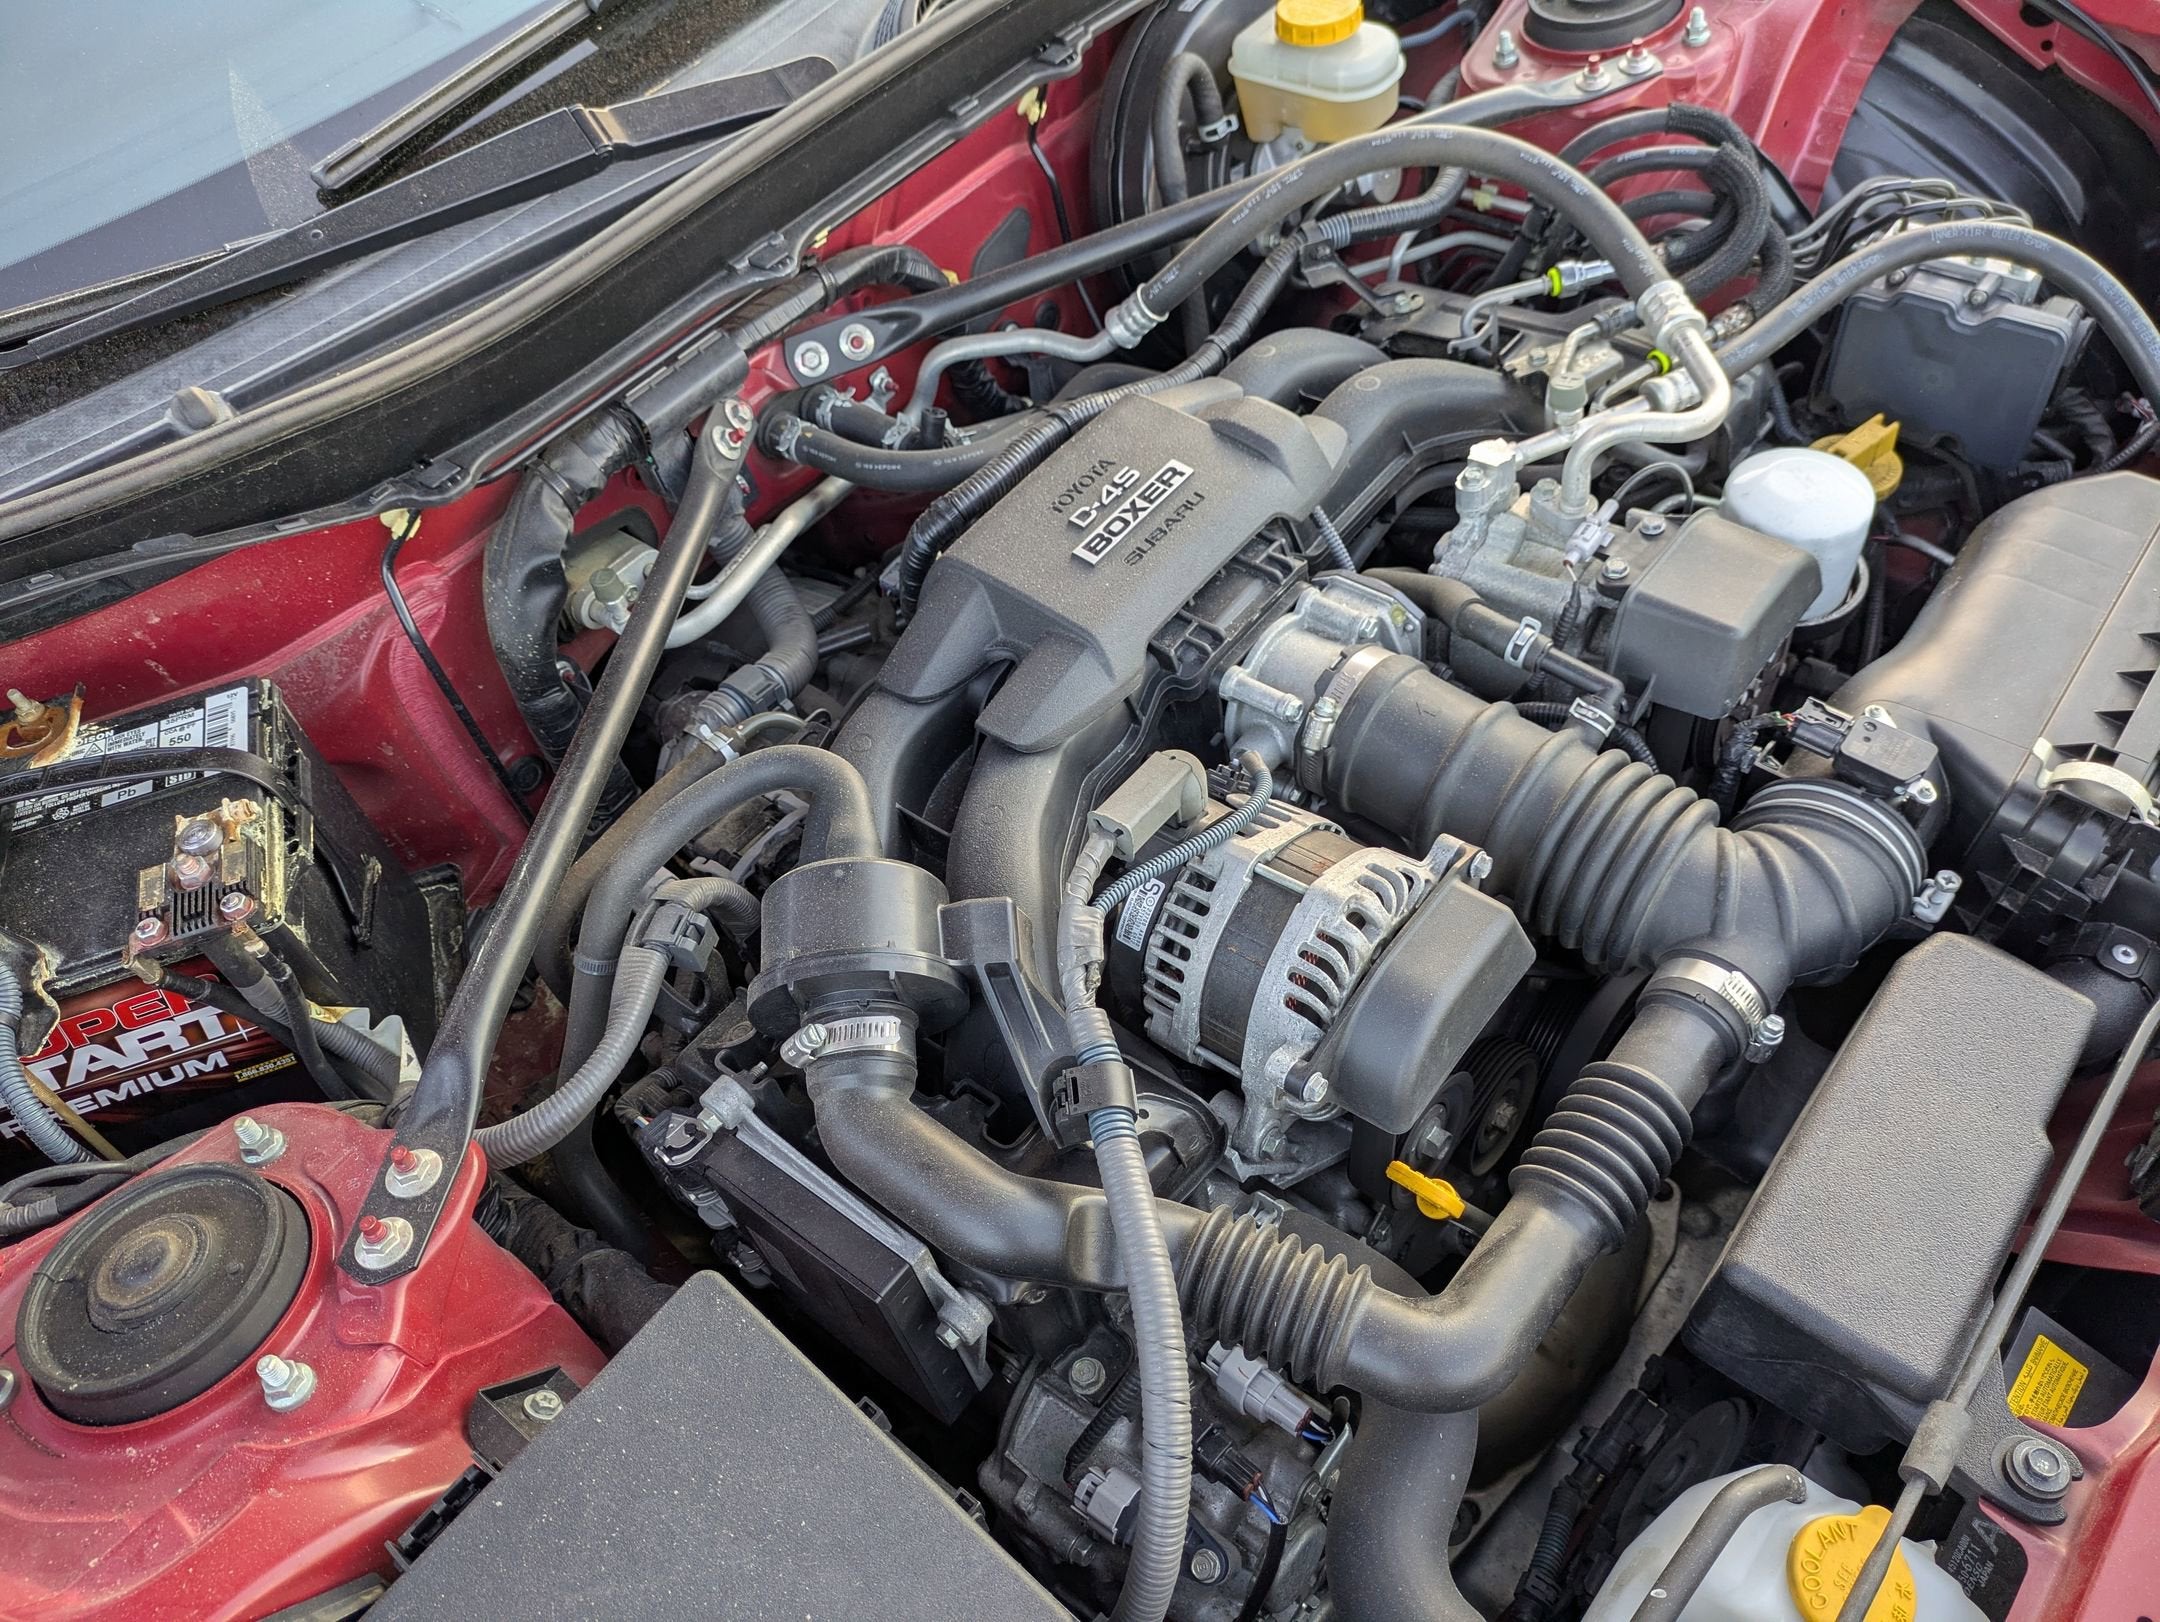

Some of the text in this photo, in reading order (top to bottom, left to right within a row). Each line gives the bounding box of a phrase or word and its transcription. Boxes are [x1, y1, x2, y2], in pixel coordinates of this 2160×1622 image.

[1052, 459, 1116, 514] TOYOTA
[1068, 466, 1141, 528] D-4S
[1081, 466, 1186, 557] BOXER
[1122, 491, 1206, 567] SUBARU
[168, 733, 192, 747] 550
[117, 788, 136, 800] Pb
[25, 1006, 223, 1092] TART
[1971, 1517, 2008, 1555] A
[1801, 1519, 1859, 1610] COOLANT
[1964, 1562, 1983, 1597] DENSO
[1980, 1560, 1995, 1587] JAPAN
